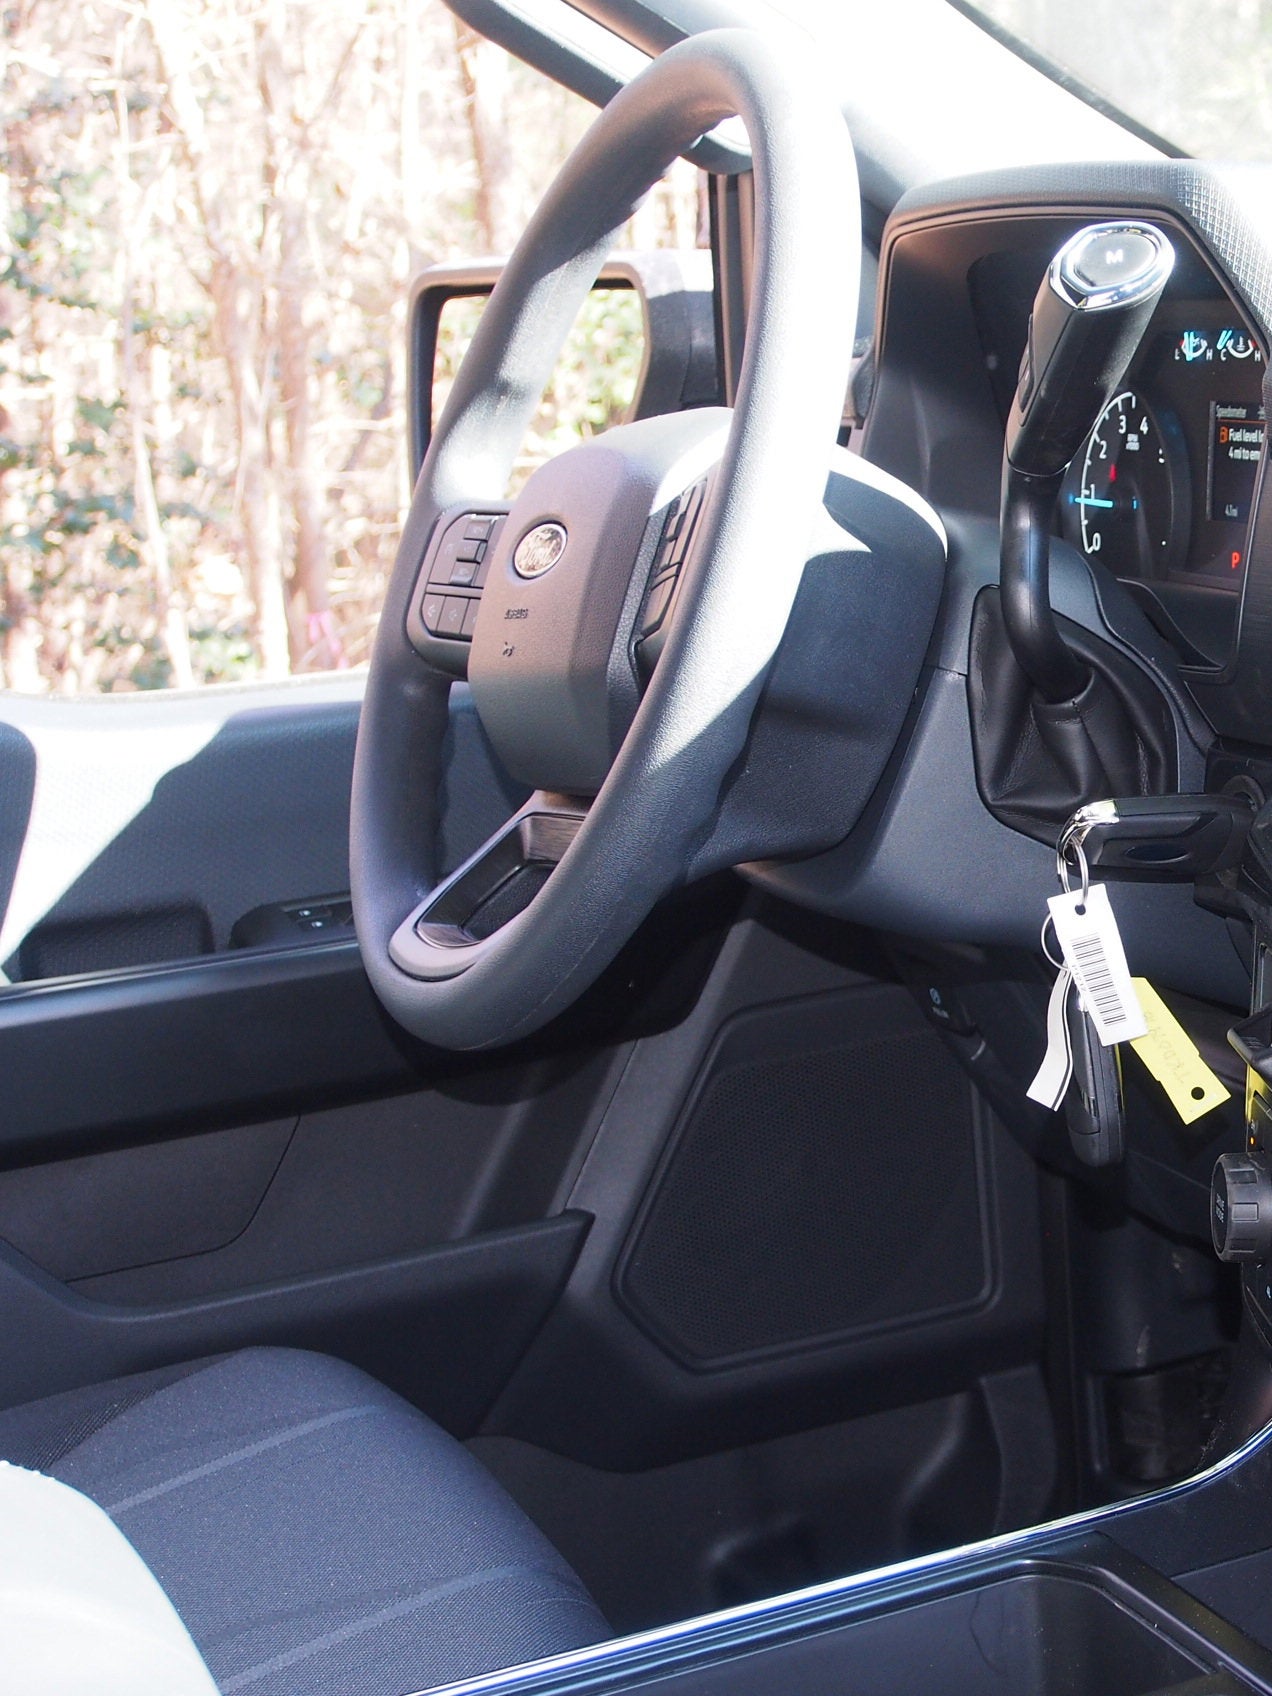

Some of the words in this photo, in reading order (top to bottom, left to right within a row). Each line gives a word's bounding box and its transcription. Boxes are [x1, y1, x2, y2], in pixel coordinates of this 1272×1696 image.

[1119, 416, 1127, 434] 3
[1140, 416, 1148, 435] 4
[1099, 441, 1107, 458] 2
[1232, 552, 1240, 569] P
